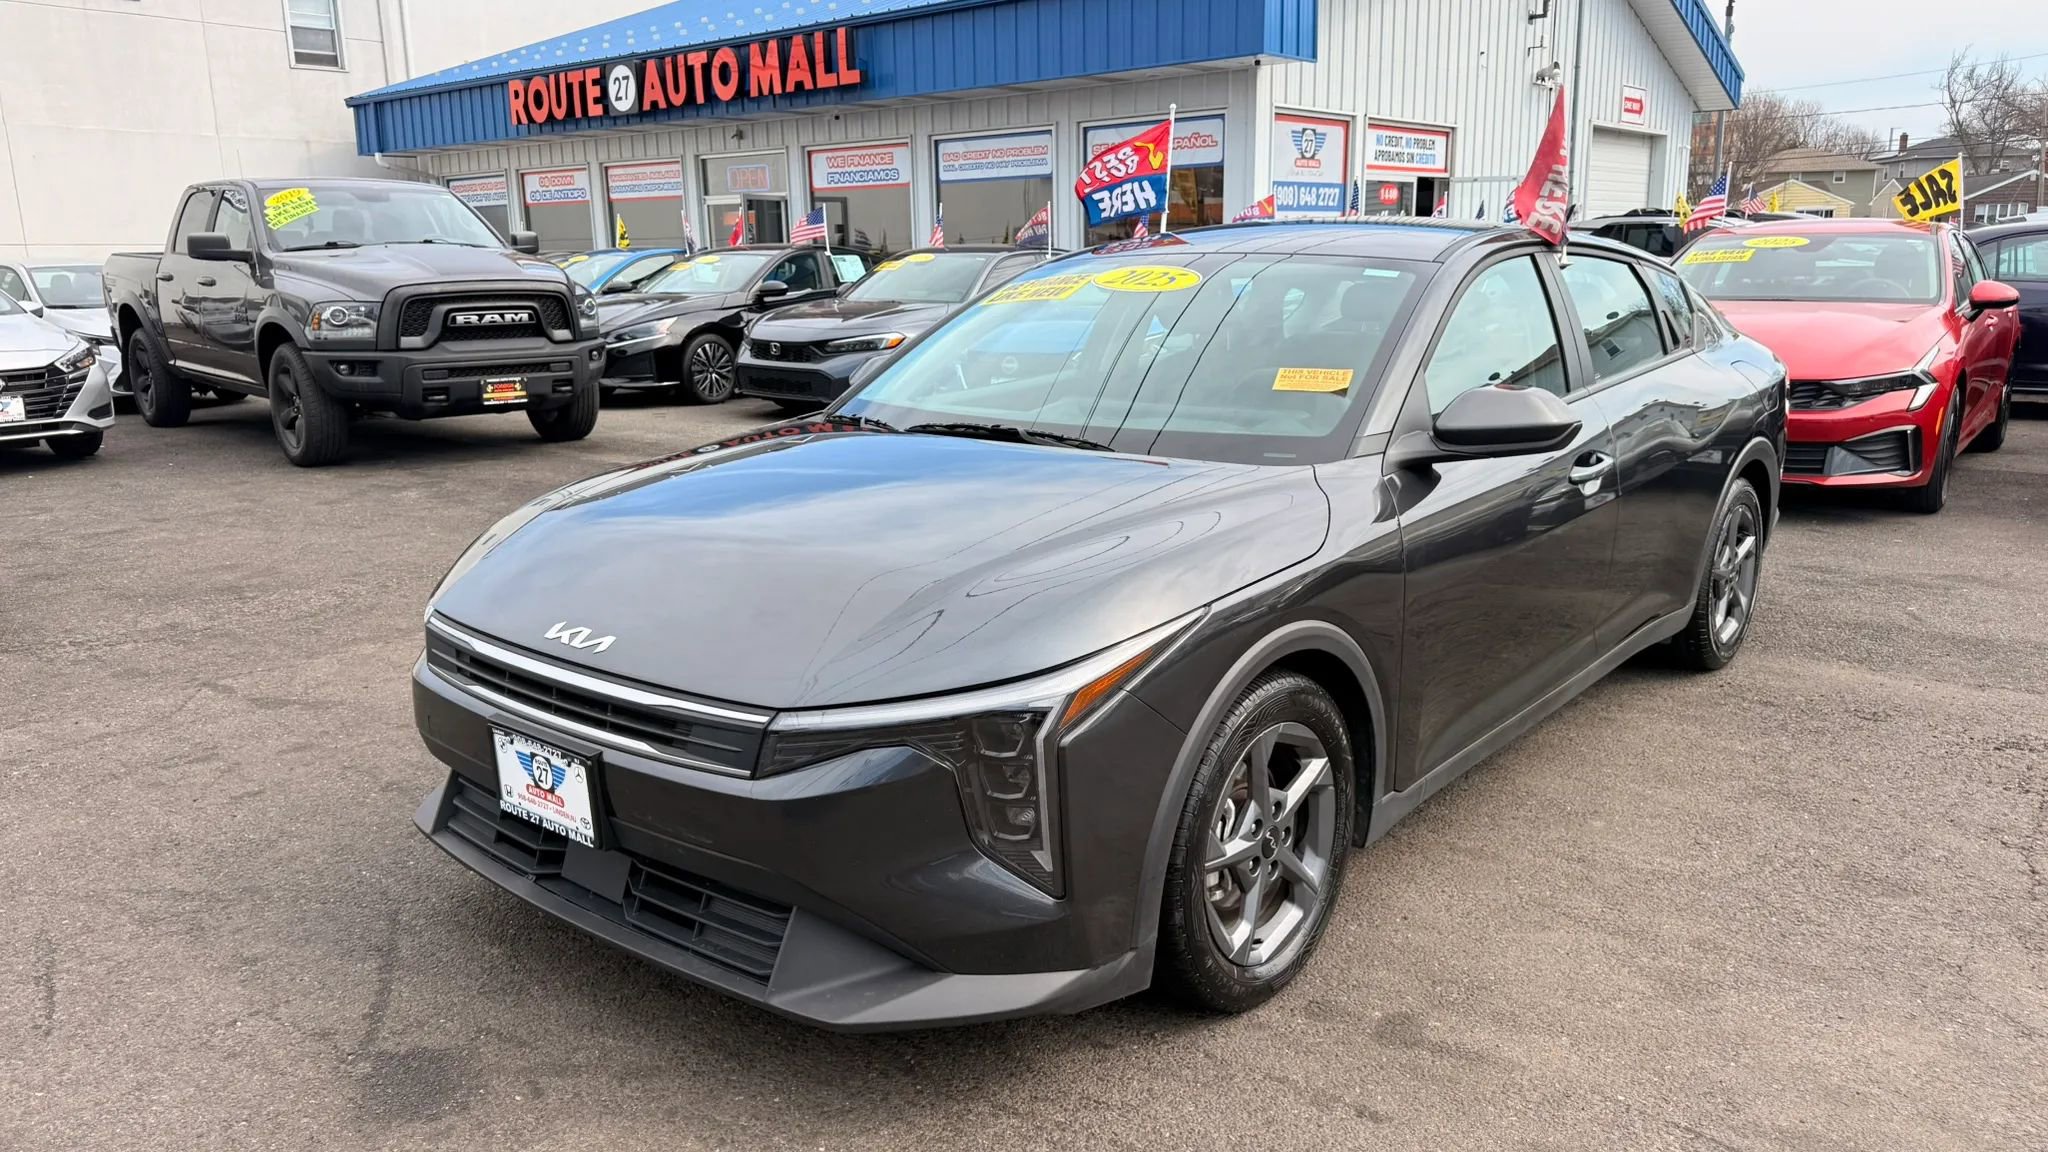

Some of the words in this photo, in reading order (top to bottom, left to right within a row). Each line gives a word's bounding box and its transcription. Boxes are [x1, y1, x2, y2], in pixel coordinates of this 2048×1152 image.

[508, 67, 603, 126] ROUTE
[613, 75, 630, 101] 27
[642, 47, 739, 112] AUTO
[750, 27, 861, 98] MALL
[1172, 132, 1217, 152] PAÑOL
[1304, 138, 1313, 154] 27
[1376, 134, 1383, 146] NO
[1406, 136, 1412, 149] NO
[1413, 138, 1436, 151] PROBLEM
[826, 155, 846, 168] WE
[847, 151, 894, 167] FINANCE
[943, 151, 960, 162] BAD
[962, 149, 991, 161] CREDIT
[992, 147, 1005, 159] NO
[1006, 145, 1048, 157] PROBLEM
[1374, 149, 1406, 163] APROBAMOS
[1406, 152, 1415, 163] SIN
[1011, 158, 1048, 167] PROBLEMA
[551, 175, 574, 187] DOWN
[731, 167, 768, 190] OPEN
[827, 168, 899, 184] FINANCIAMOS
[541, 190, 552, 201] DE
[553, 187, 586, 200] ANTICIPO
[1300, 186, 1317, 206] 648
[1318, 187, 1340, 207] 2727
[1102, 270, 1189, 287] 2025
[456, 312, 529, 325] RAM
[543, 621, 617, 655] KIA
[536, 766, 549, 786] 27
[528, 786, 545, 798] AUTO
[547, 791, 563, 805] MALL
[500, 799, 529, 821] ROUTE
[529, 813, 540, 825] 27
[542, 819, 567, 837] AUTO
[568, 829, 595, 849] MALL
